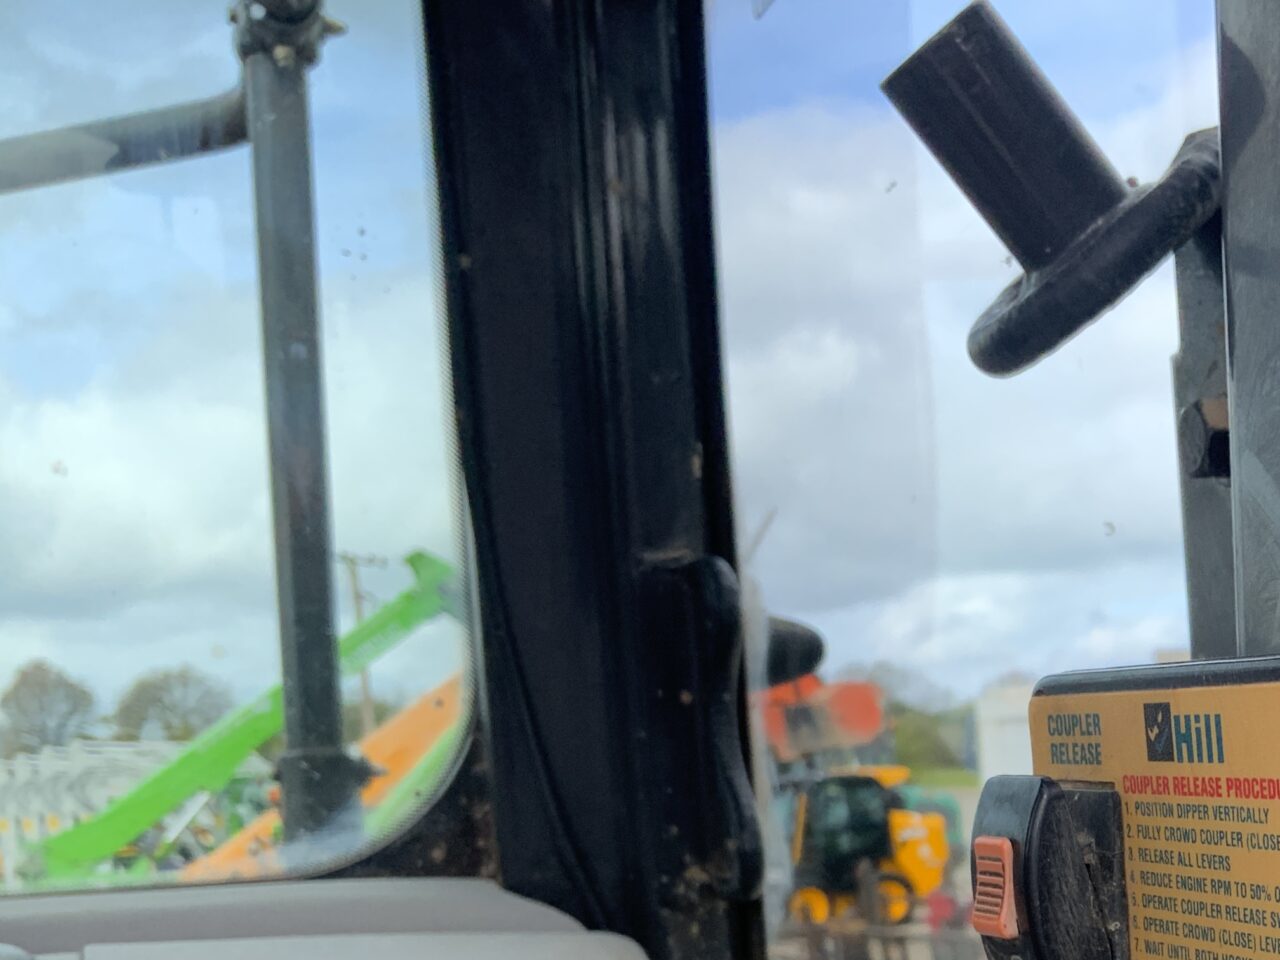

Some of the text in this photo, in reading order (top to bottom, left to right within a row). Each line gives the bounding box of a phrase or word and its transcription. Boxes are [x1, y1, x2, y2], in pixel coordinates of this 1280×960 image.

[1047, 713, 1102, 736] COUPLER
[1173, 713, 1224, 763] Hill
[1051, 742, 1102, 765] RELEASE
[1123, 775, 1170, 796] COUPLER
[1172, 776, 1222, 797] RELEASE
[1135, 801, 1174, 818] POSITION
[1177, 803, 1209, 820] DIPPER
[1212, 805, 1269, 824] VERTICALLY
[1136, 824, 1161, 840] FULLY
[1164, 826, 1197, 844] CROWD
[1200, 829, 1243, 848] COUPLER
[1138, 847, 1175, 865] RELEASE
[1177, 851, 1194, 867] ALL
[1196, 853, 1231, 871] LEVERS
[1140, 870, 1173, 889] REDUCE
[1176, 874, 1208, 893] ENGINE
[1210, 879, 1232, 896] RPM
[1234, 881, 1247, 898] TO
[1250, 883, 1271, 902] 50%
[1141, 893, 1178, 913] OPERATE
[1181, 899, 1222, 920] COUPLER
[1225, 905, 1267, 926] RELEASE
[1143, 916, 1180, 936] OPERATE
[1183, 922, 1216, 942] CROWD
[1219, 928, 1256, 953] (CLOSE)
[1144, 939, 1164, 956] WAIT
